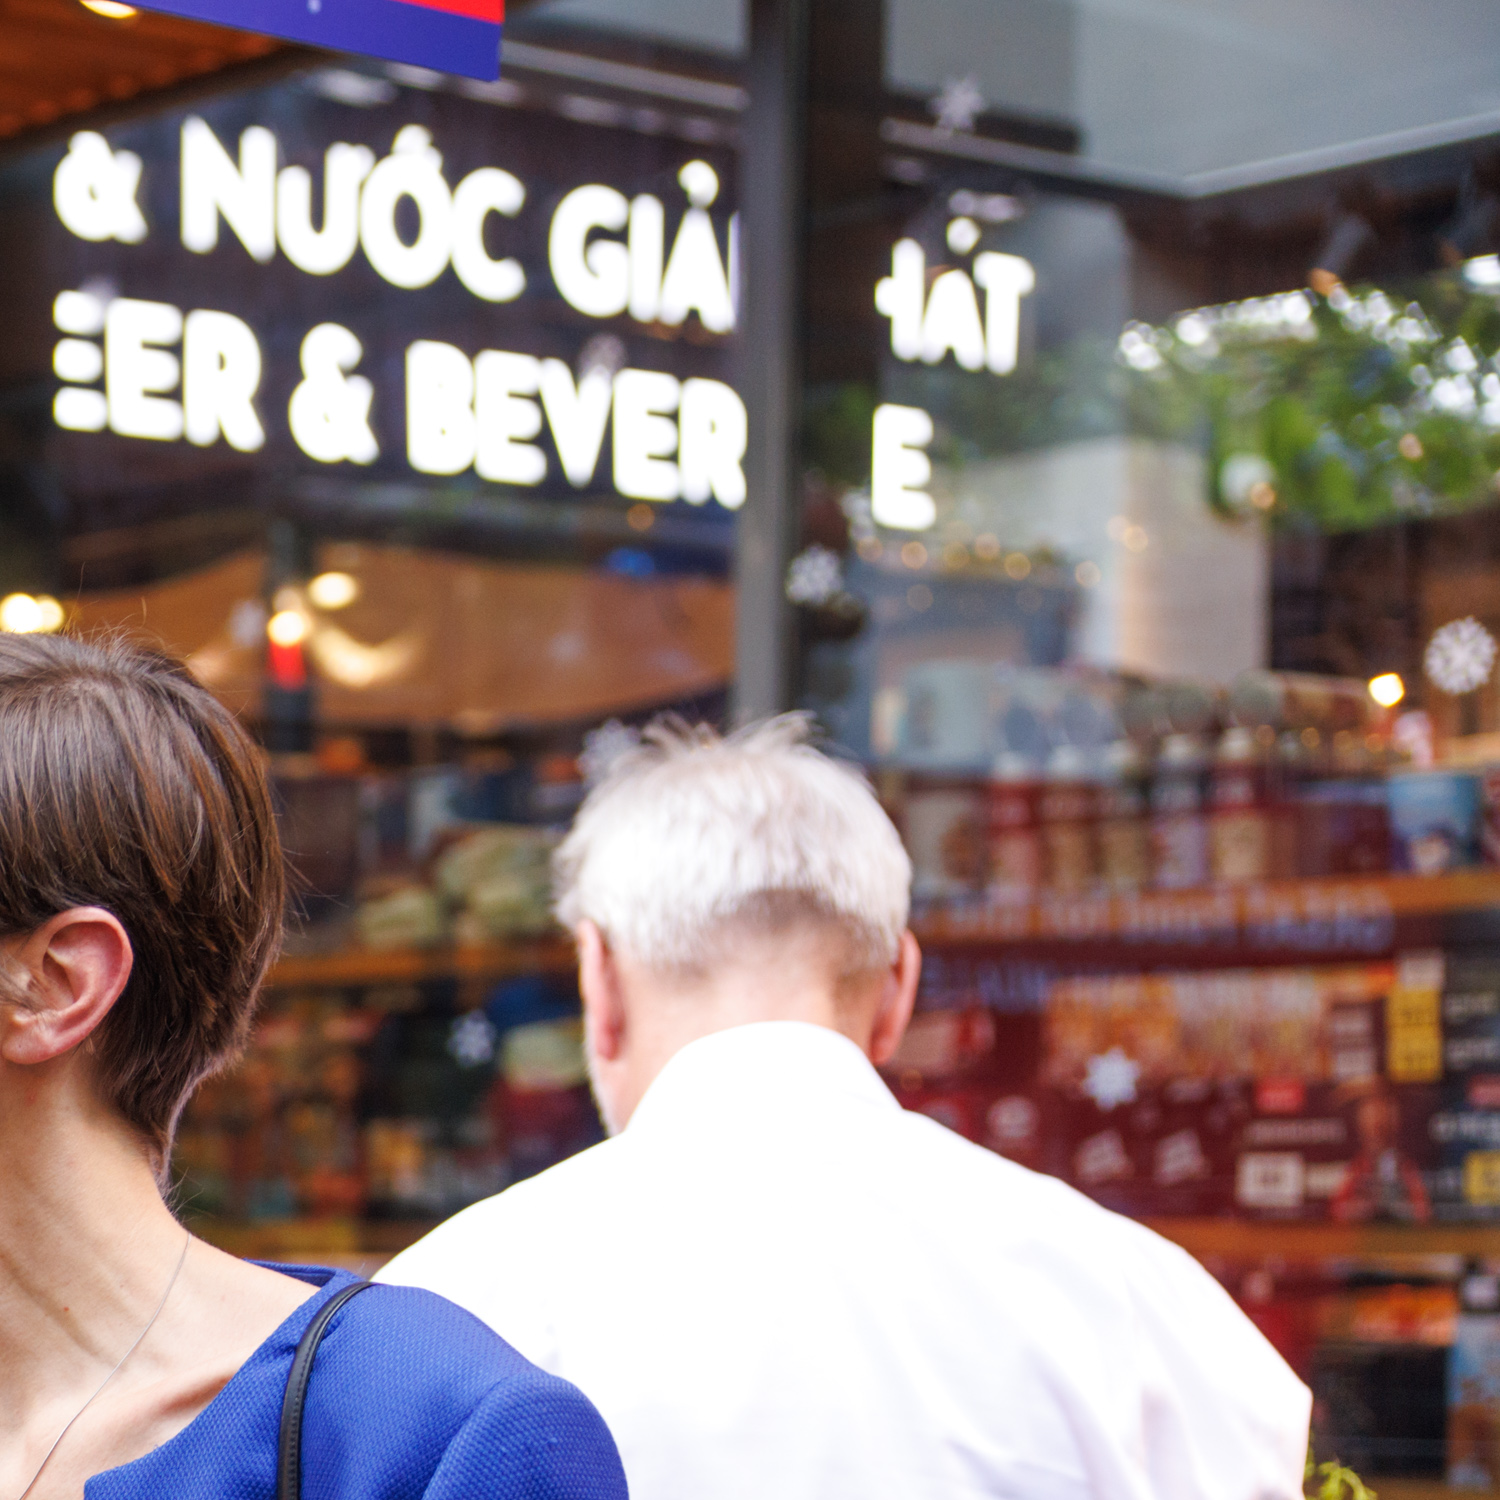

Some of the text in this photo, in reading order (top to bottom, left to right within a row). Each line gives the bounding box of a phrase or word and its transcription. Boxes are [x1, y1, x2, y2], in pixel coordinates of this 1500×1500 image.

[53, 131, 148, 244] &
[549, 160, 740, 334] GIẢ
[875, 216, 1035, 376] HÁT
[53, 290, 937, 531] EER & BEVERE
